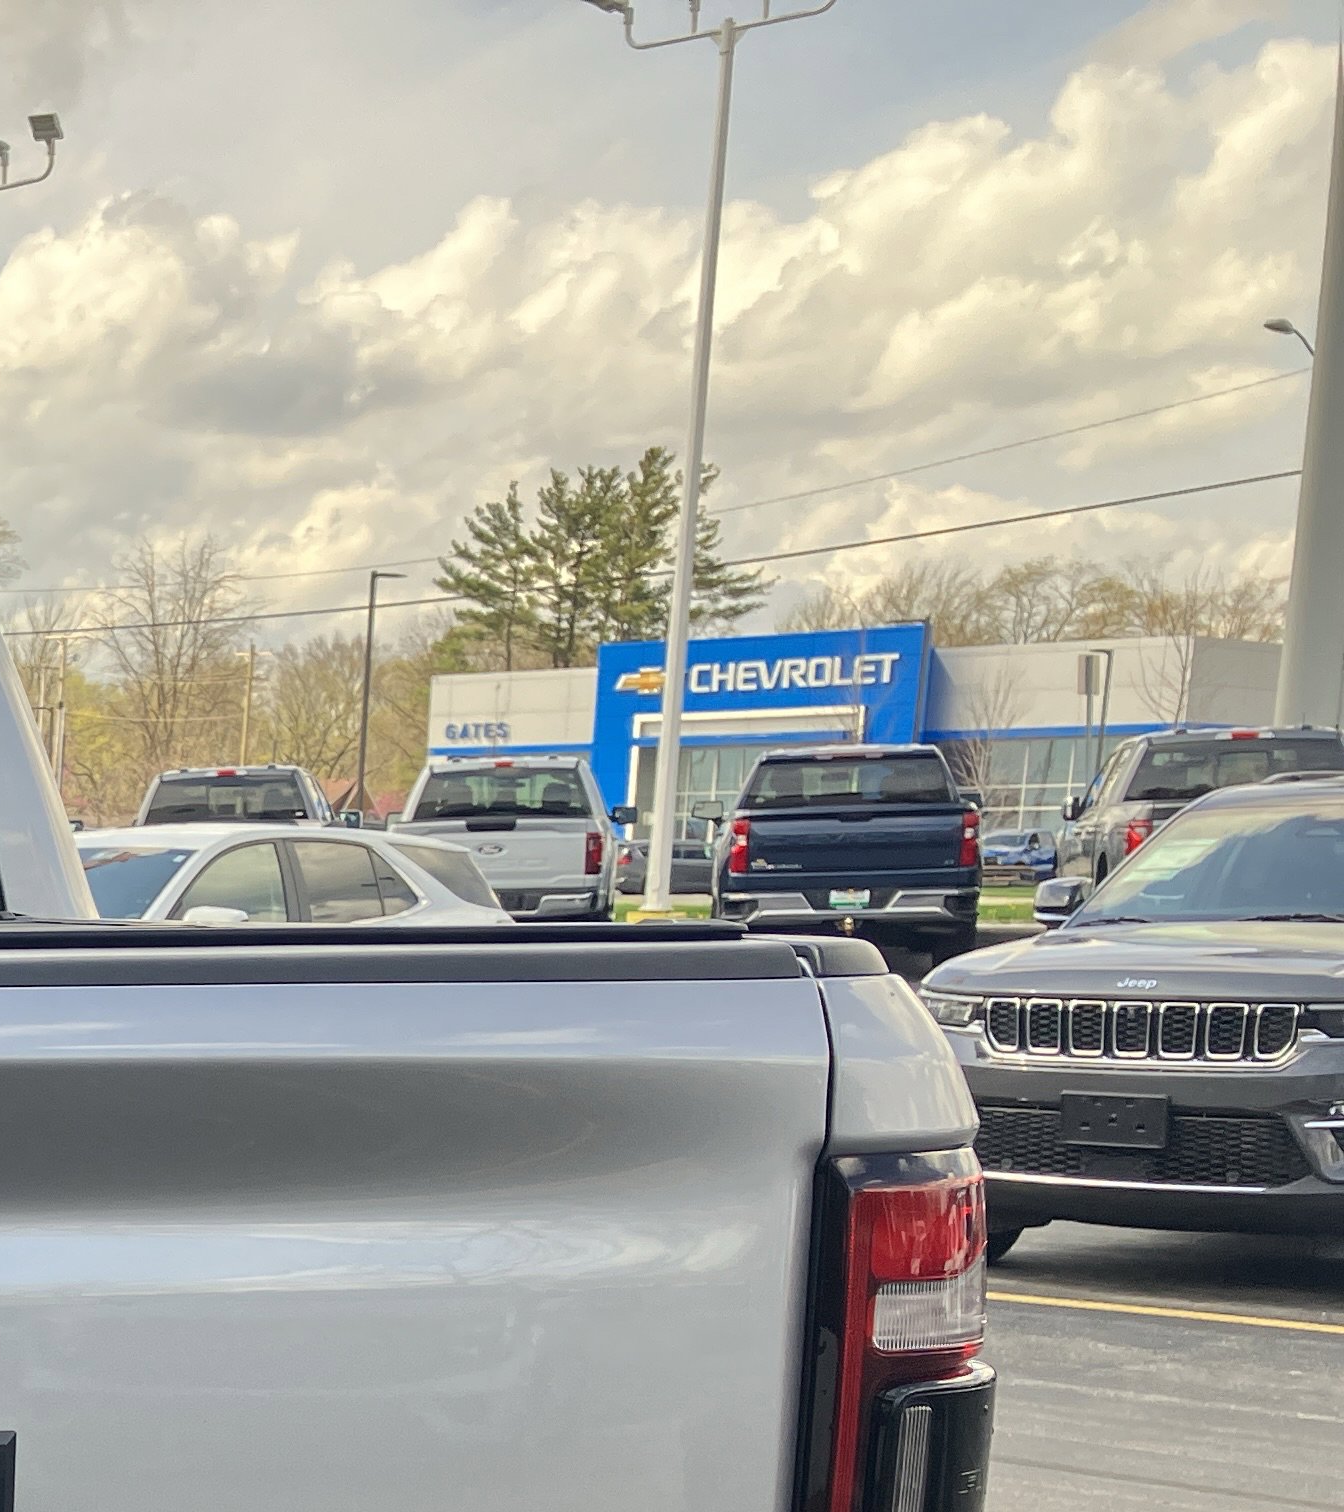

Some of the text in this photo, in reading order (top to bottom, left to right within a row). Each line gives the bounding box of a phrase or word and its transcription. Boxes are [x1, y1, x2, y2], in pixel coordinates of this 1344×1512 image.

[690, 653, 900, 693] CHEVROLET
[445, 722, 509, 739] GATES
[1116, 978, 1157, 989] Jeep
